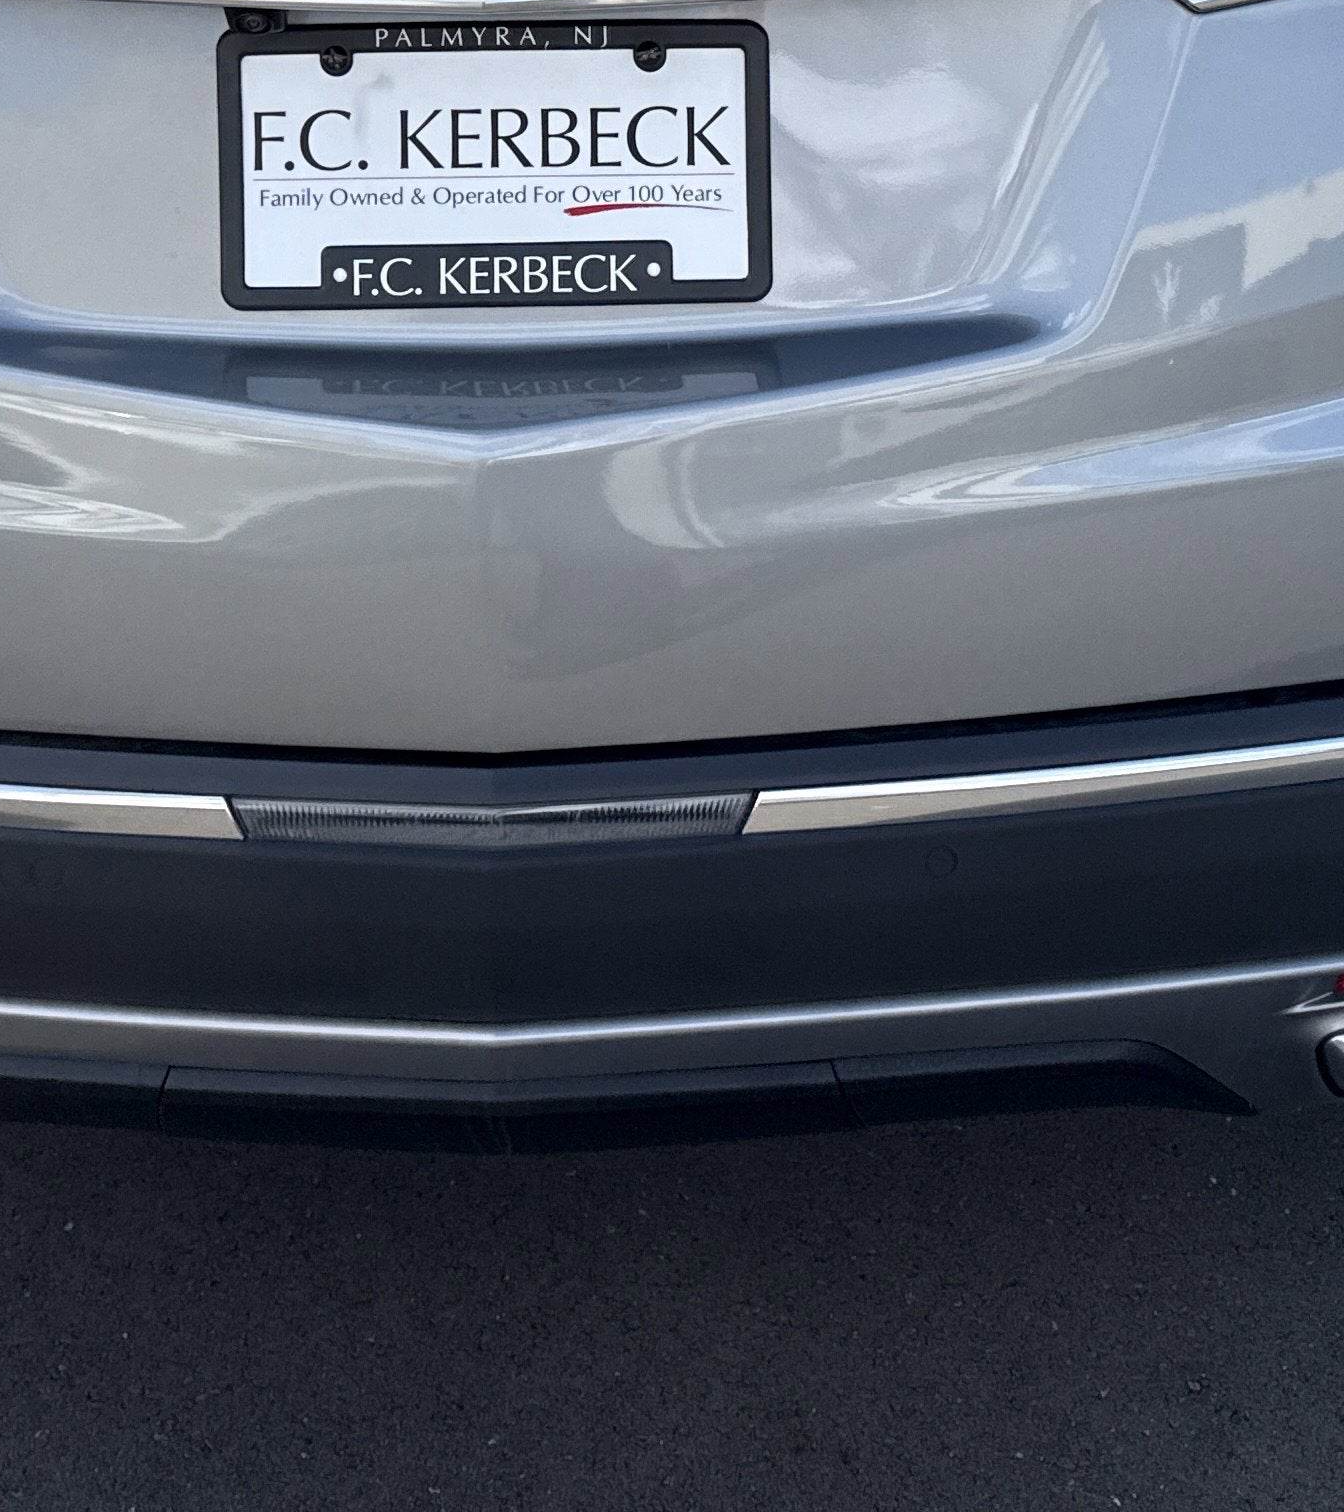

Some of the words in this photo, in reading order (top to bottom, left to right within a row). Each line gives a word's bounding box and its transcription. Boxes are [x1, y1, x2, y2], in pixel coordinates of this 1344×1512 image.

[374, 25, 551, 50] PALMYRA,
[573, 25, 610, 48] NJ
[253, 108, 369, 172] F.C.
[399, 105, 731, 170] KERBECK
[260, 187, 324, 211] Family
[329, 186, 404, 206] Owned
[410, 187, 426, 205] &
[432, 184, 527, 208] Operated
[533, 185, 565, 204] For
[572, 184, 622, 203] Over
[628, 184, 664, 202] 100
[670, 183, 723, 202] Years
[351, 256, 423, 297] F.C.
[439, 253, 638, 296] KERBECK
